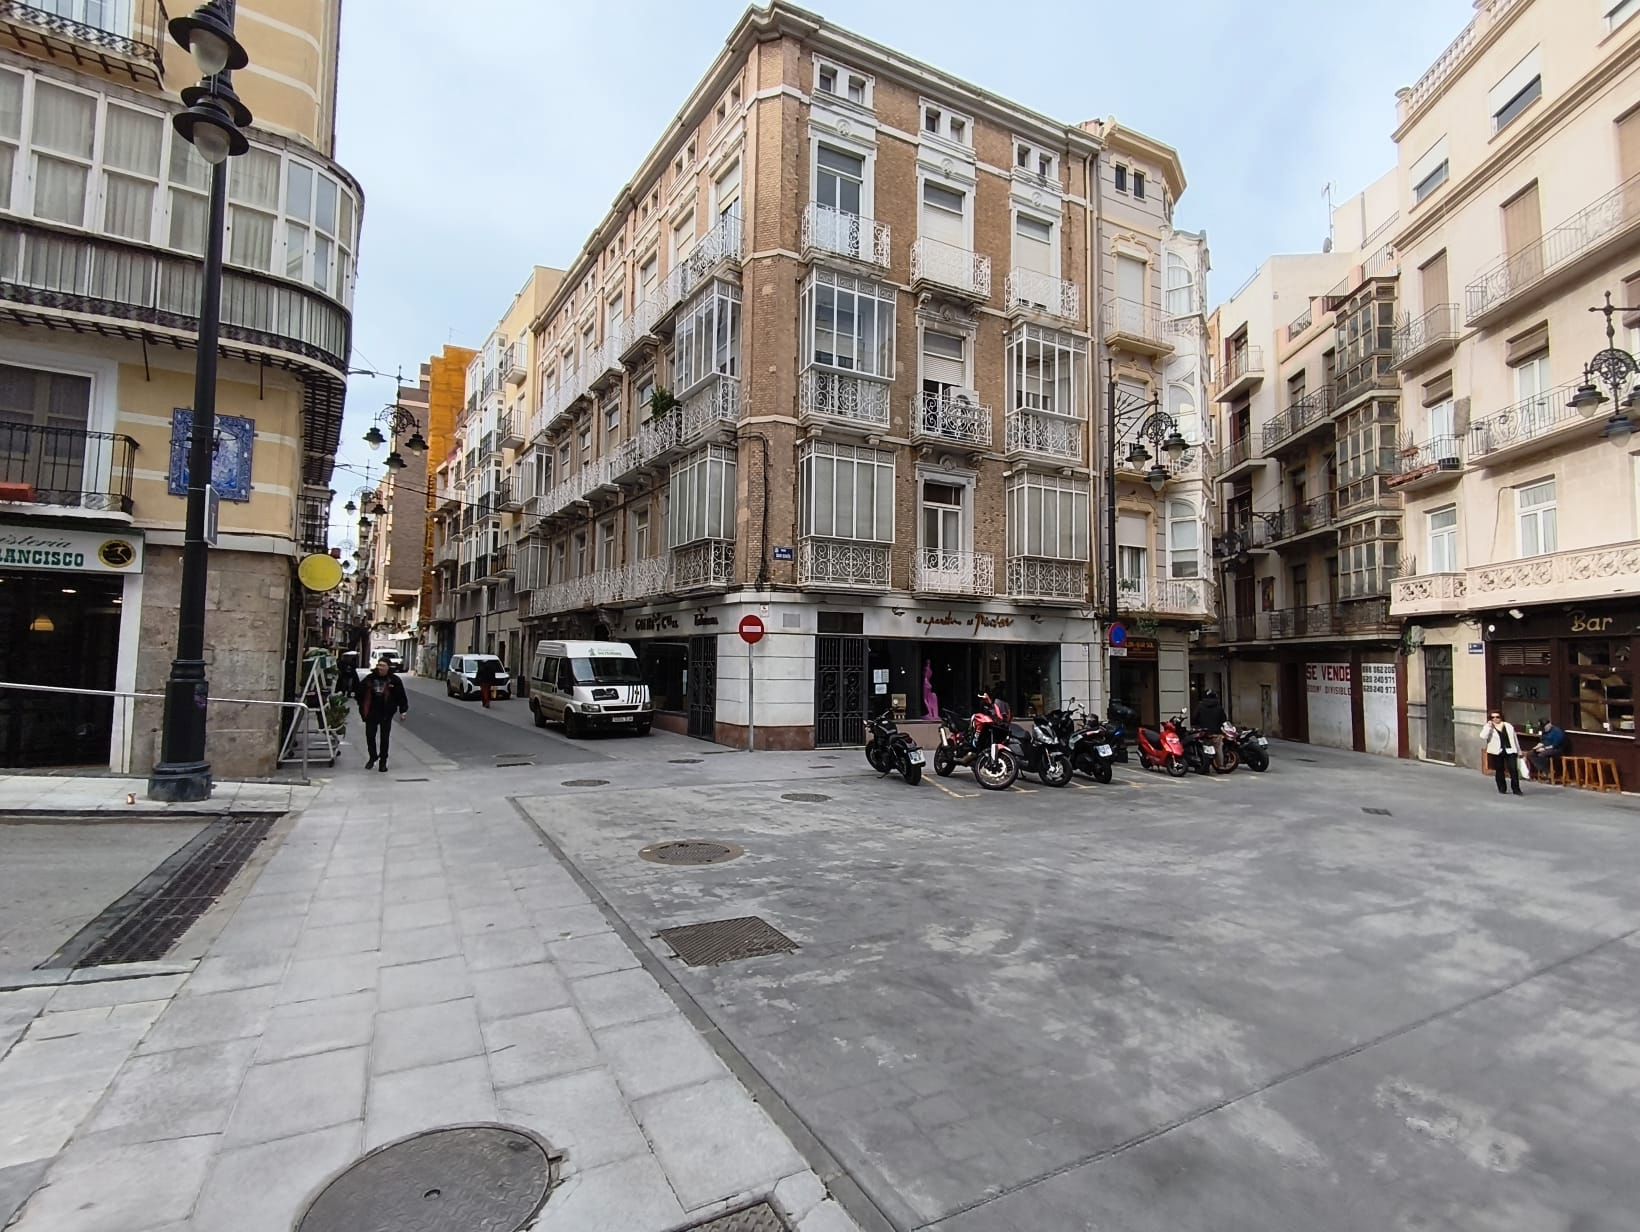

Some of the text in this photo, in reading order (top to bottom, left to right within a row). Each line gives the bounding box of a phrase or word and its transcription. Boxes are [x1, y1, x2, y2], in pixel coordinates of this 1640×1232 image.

[1570, 610, 1613, 632] Bar
[1306, 665, 1351, 681] SE VENDE
